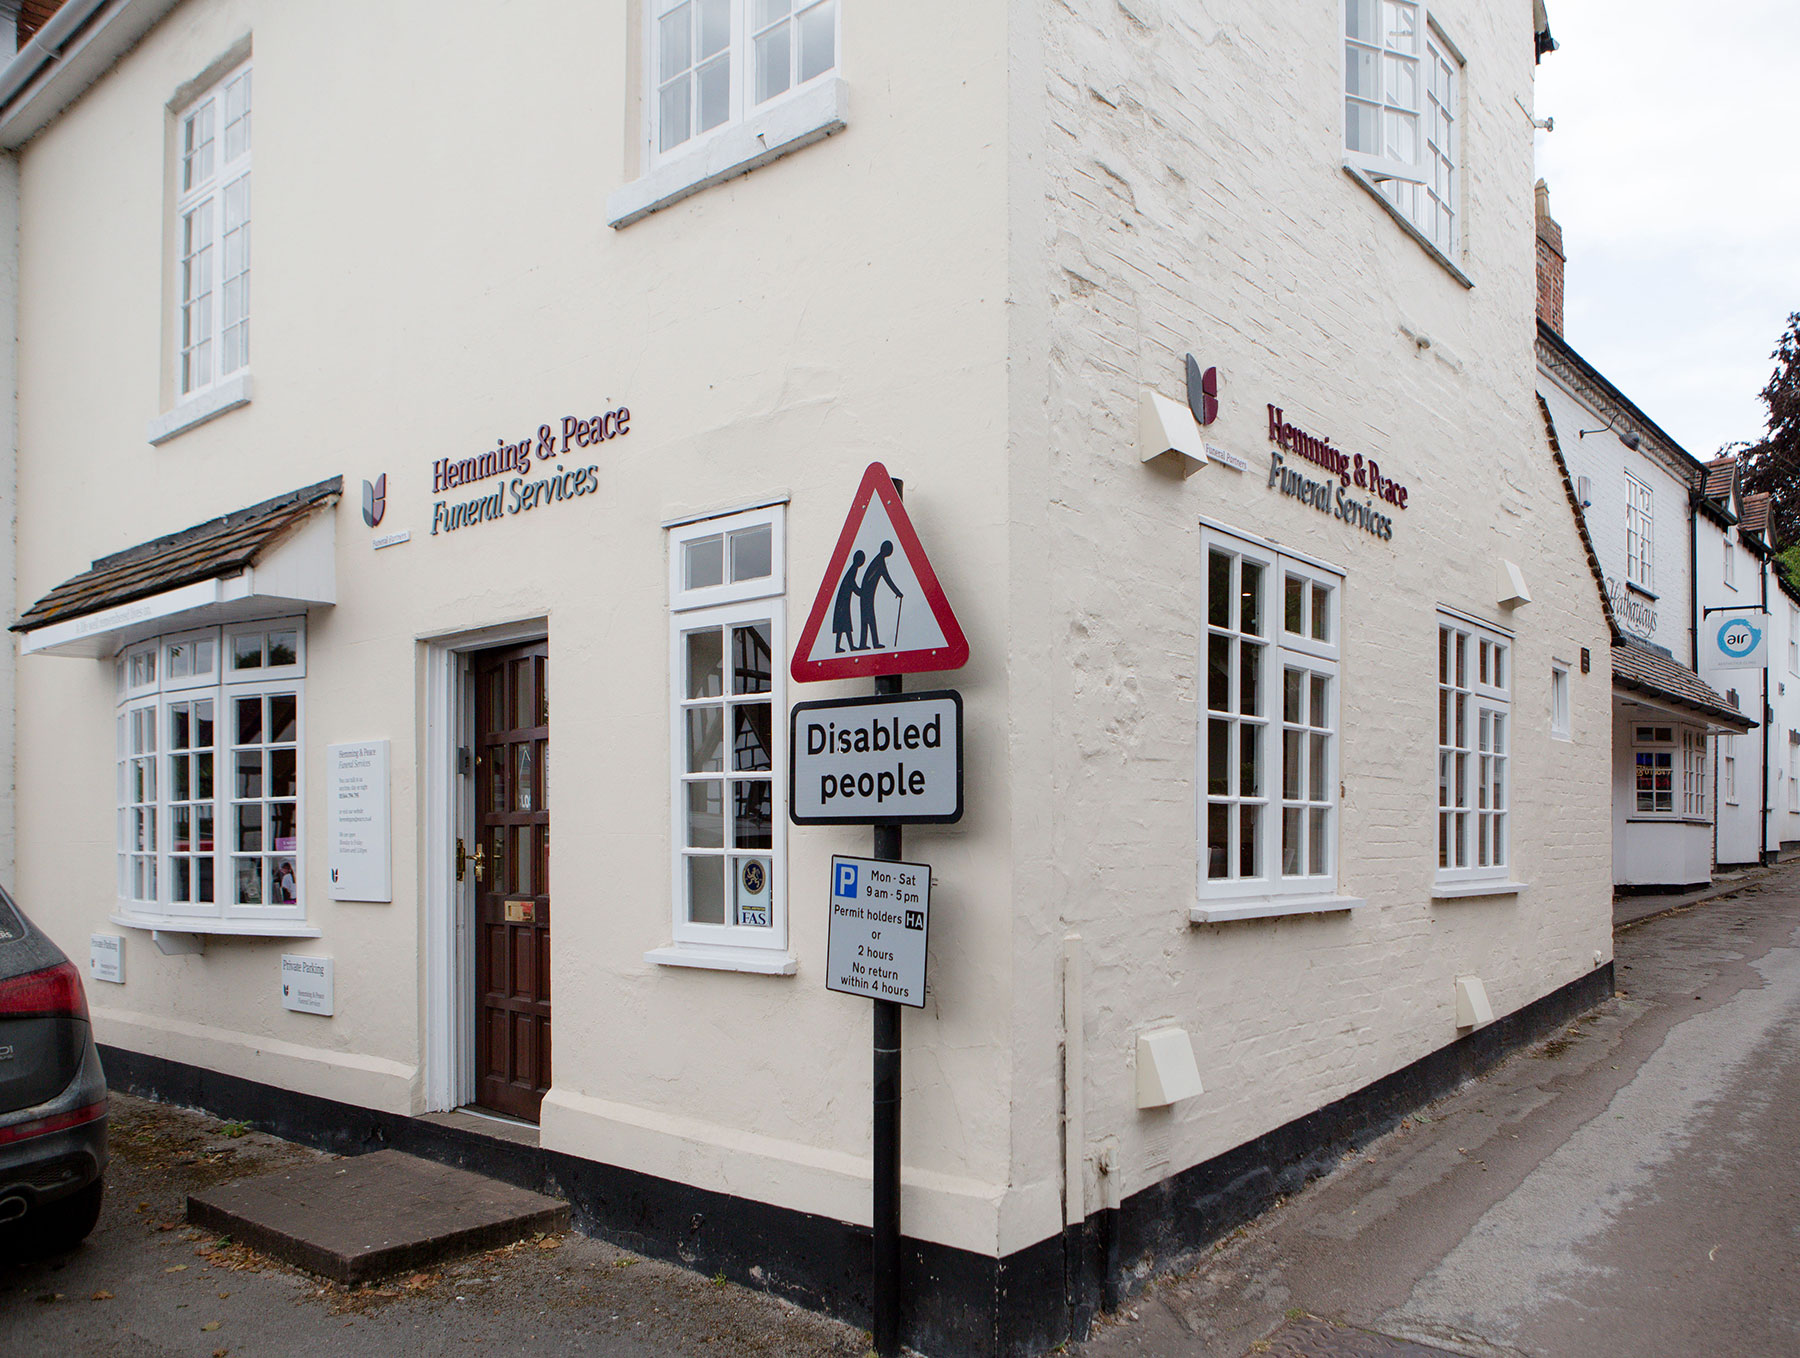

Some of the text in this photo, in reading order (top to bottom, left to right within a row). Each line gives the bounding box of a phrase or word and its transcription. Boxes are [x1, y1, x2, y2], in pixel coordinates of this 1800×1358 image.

[432, 406, 631, 494] Hemming & Peace
[1206, 443, 1226, 461] Funeral
[1267, 403, 1408, 510] Hemming & Peace
[430, 464, 599, 535] Funeral Services
[1268, 451, 1393, 541] Funeral Services
[1727, 633, 1749, 645] air
[808, 713, 941, 755] Disabled
[821, 763, 925, 804] people
[840, 866, 856, 895] P
[871, 870, 891, 883] Mon
[899, 873, 916, 886] Sat
[742, 912, 766, 925] FAS
[834, 904, 923, 928] Permit holders HA
[871, 930, 881, 940] or
[858, 945, 894, 961] 2 hours
[283, 959, 324, 977] Private Parking
[852, 962, 898, 980] No return
[841, 975, 909, 997] within 4 hours
